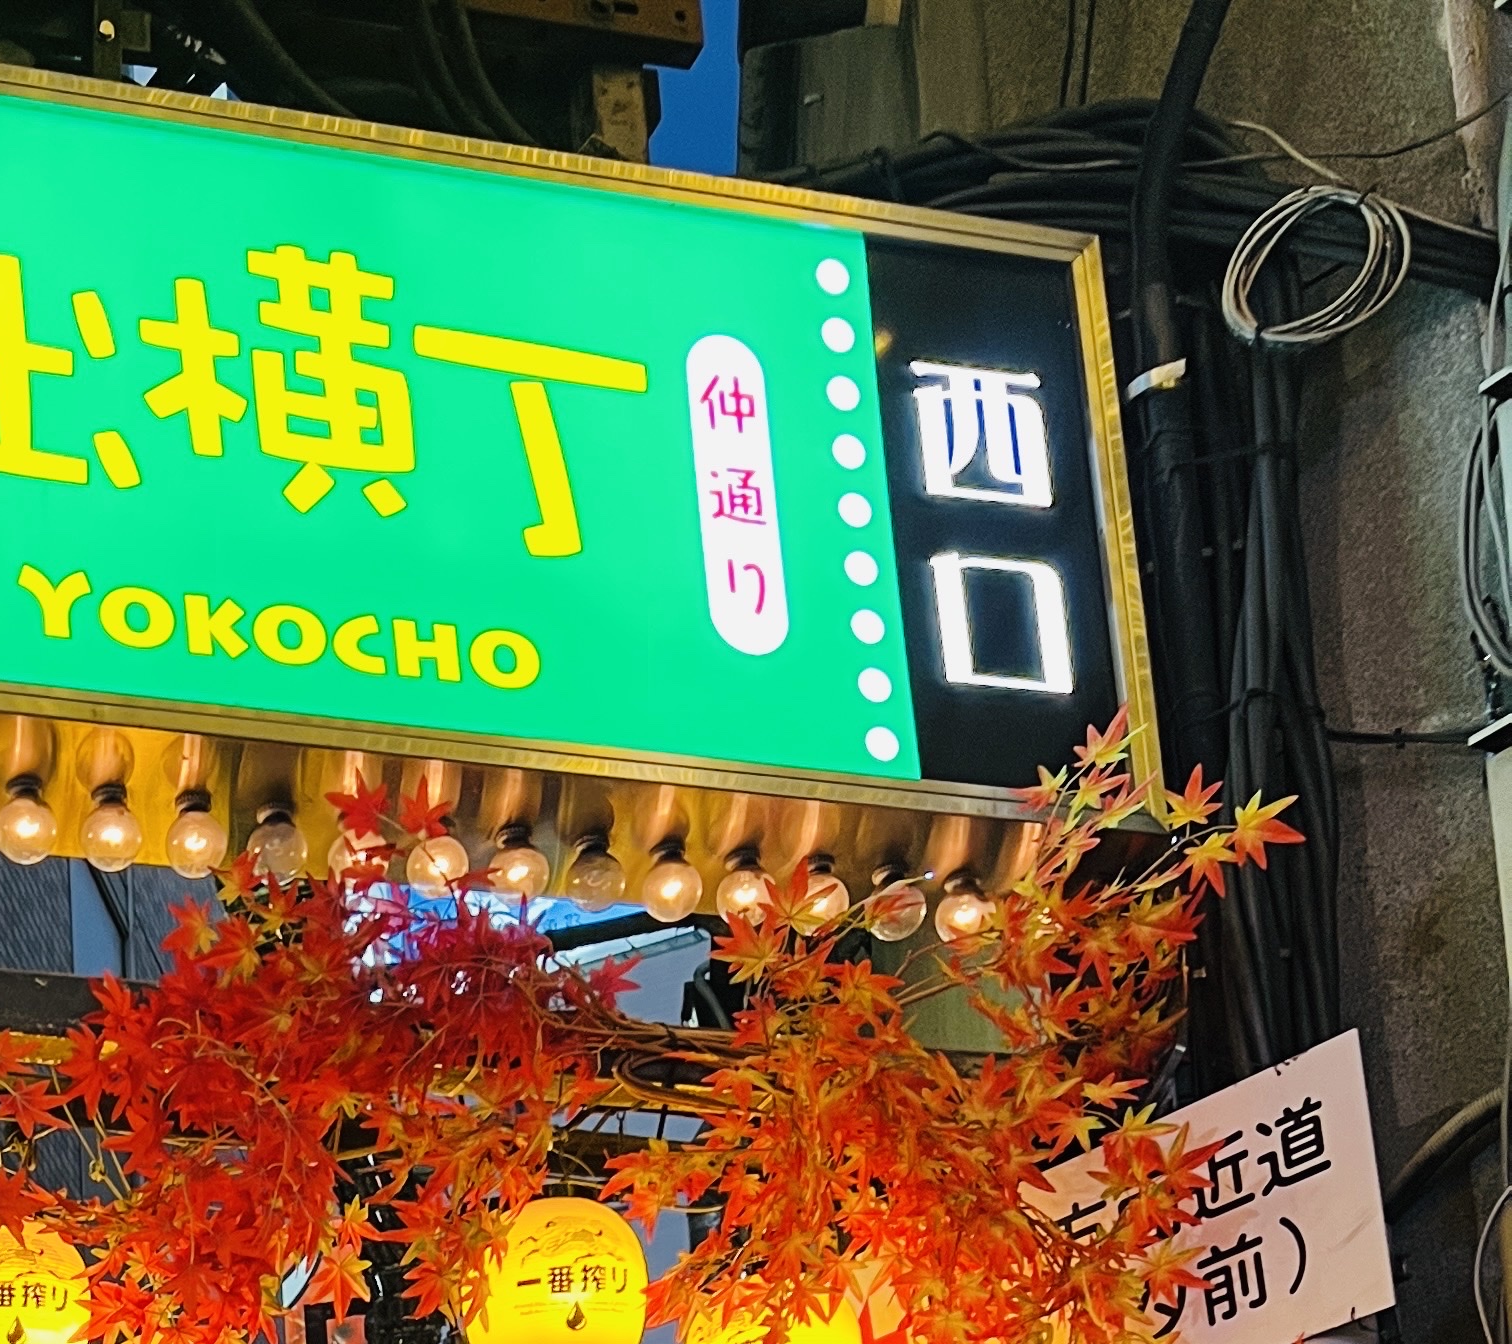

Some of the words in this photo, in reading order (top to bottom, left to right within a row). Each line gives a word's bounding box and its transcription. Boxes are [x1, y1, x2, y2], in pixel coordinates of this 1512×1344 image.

[699, 374, 768, 615] 仲通り
[908, 359, 1075, 695] 西口
[18, 563, 541, 691] YOKOCHO
[517, 1264, 628, 1294] 一番搾り
